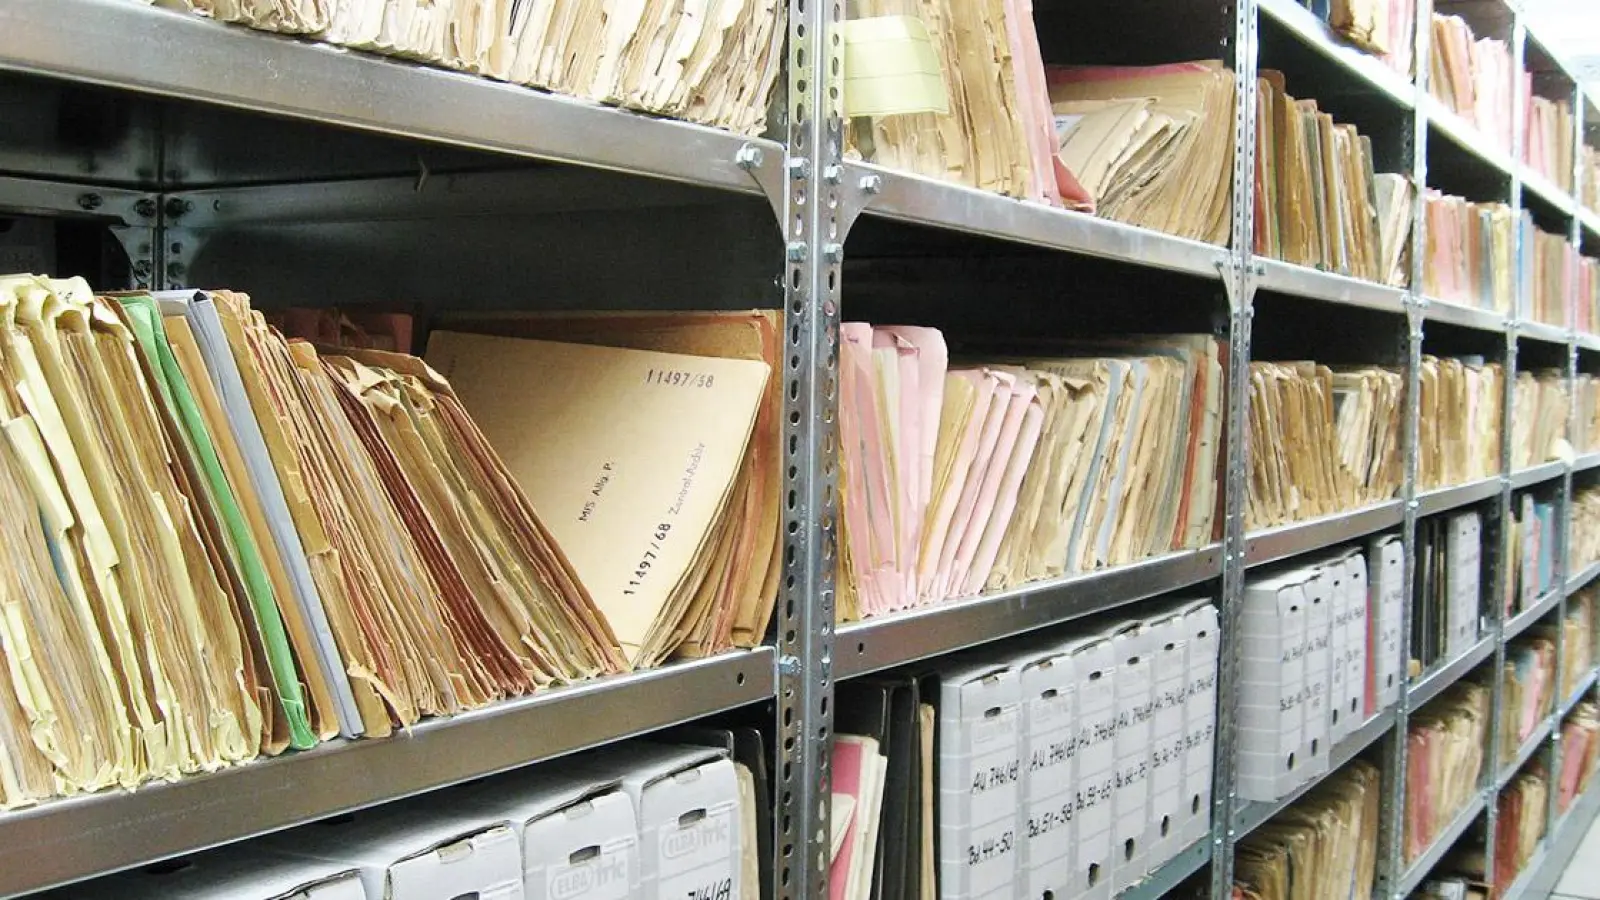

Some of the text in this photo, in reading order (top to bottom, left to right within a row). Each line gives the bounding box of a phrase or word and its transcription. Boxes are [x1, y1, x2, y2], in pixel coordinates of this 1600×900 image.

[623, 523, 671, 595] 11497/68
[1029, 749, 1045, 771] AU
[970, 771, 987, 794] AU
